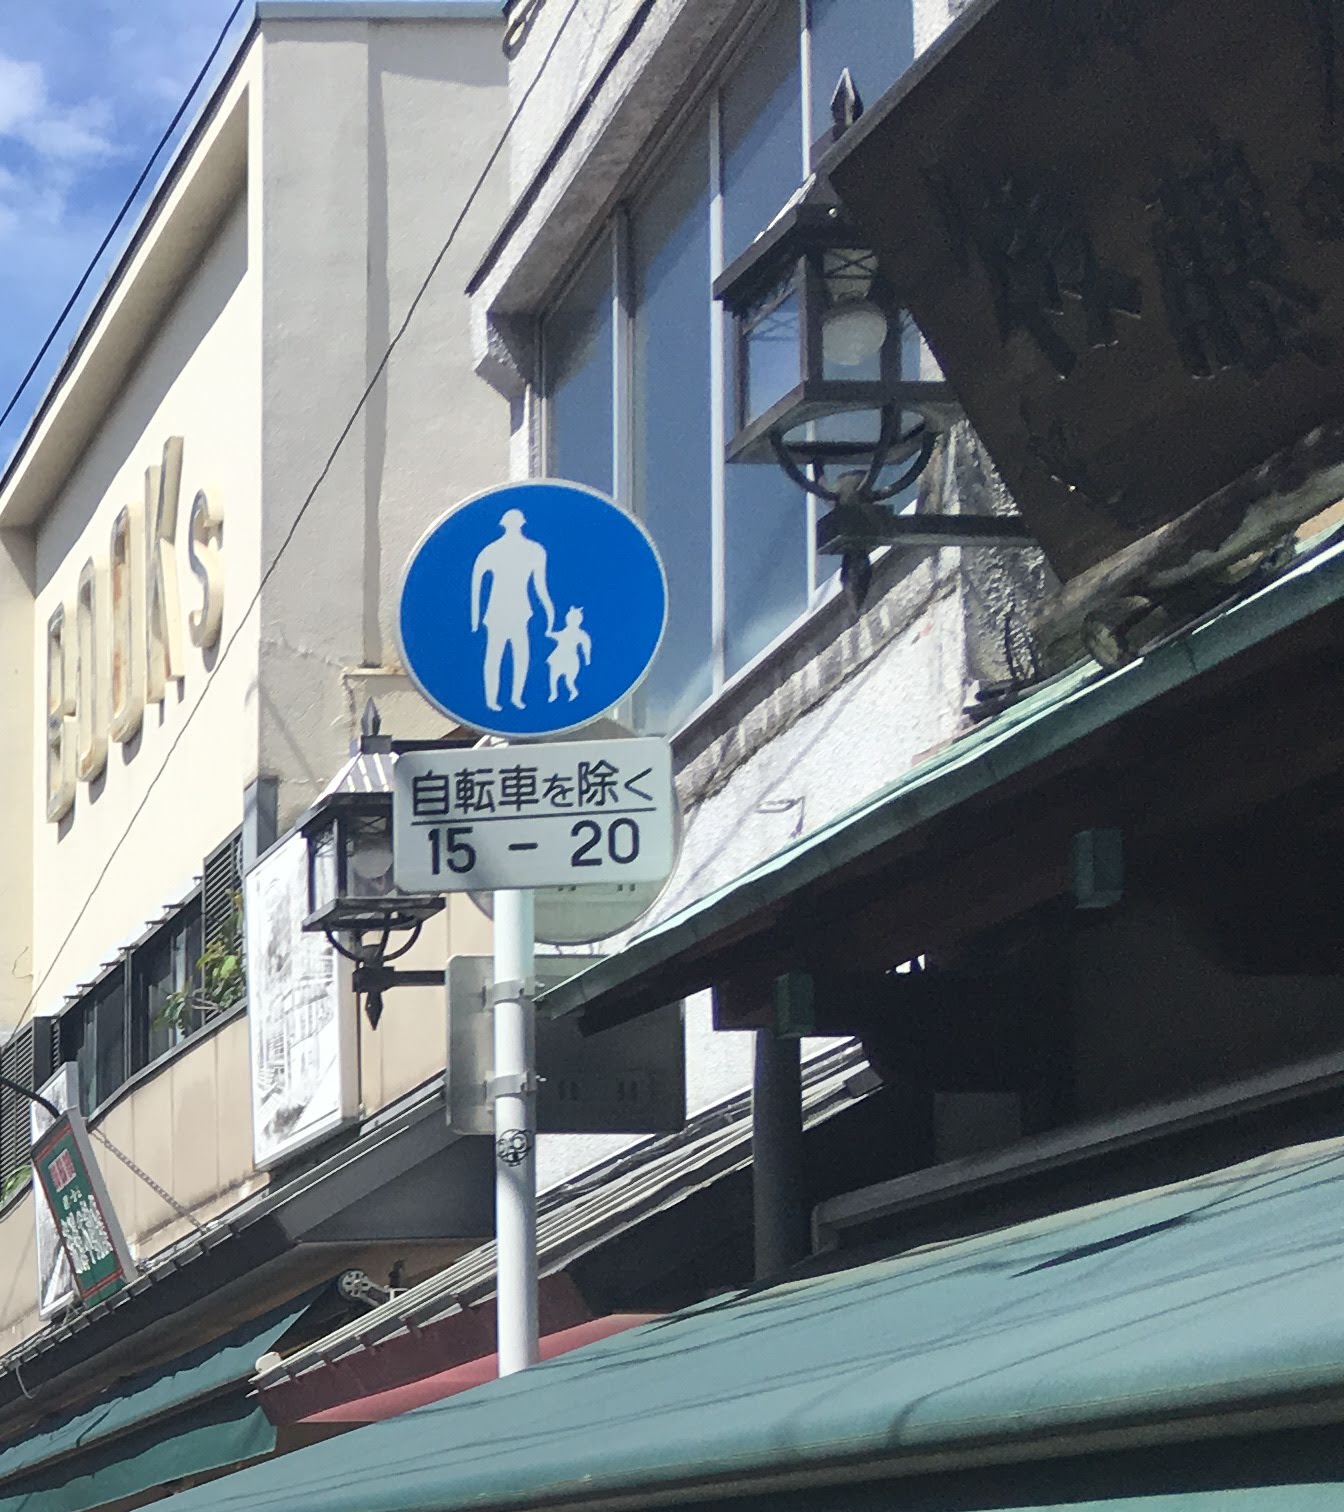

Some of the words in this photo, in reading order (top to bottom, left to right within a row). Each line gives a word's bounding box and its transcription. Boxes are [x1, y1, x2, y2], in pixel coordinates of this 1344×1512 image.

[412, 759, 653, 816] 自転車を除く
[428, 827, 477, 875] 15
[571, 817, 640, 867] 20
